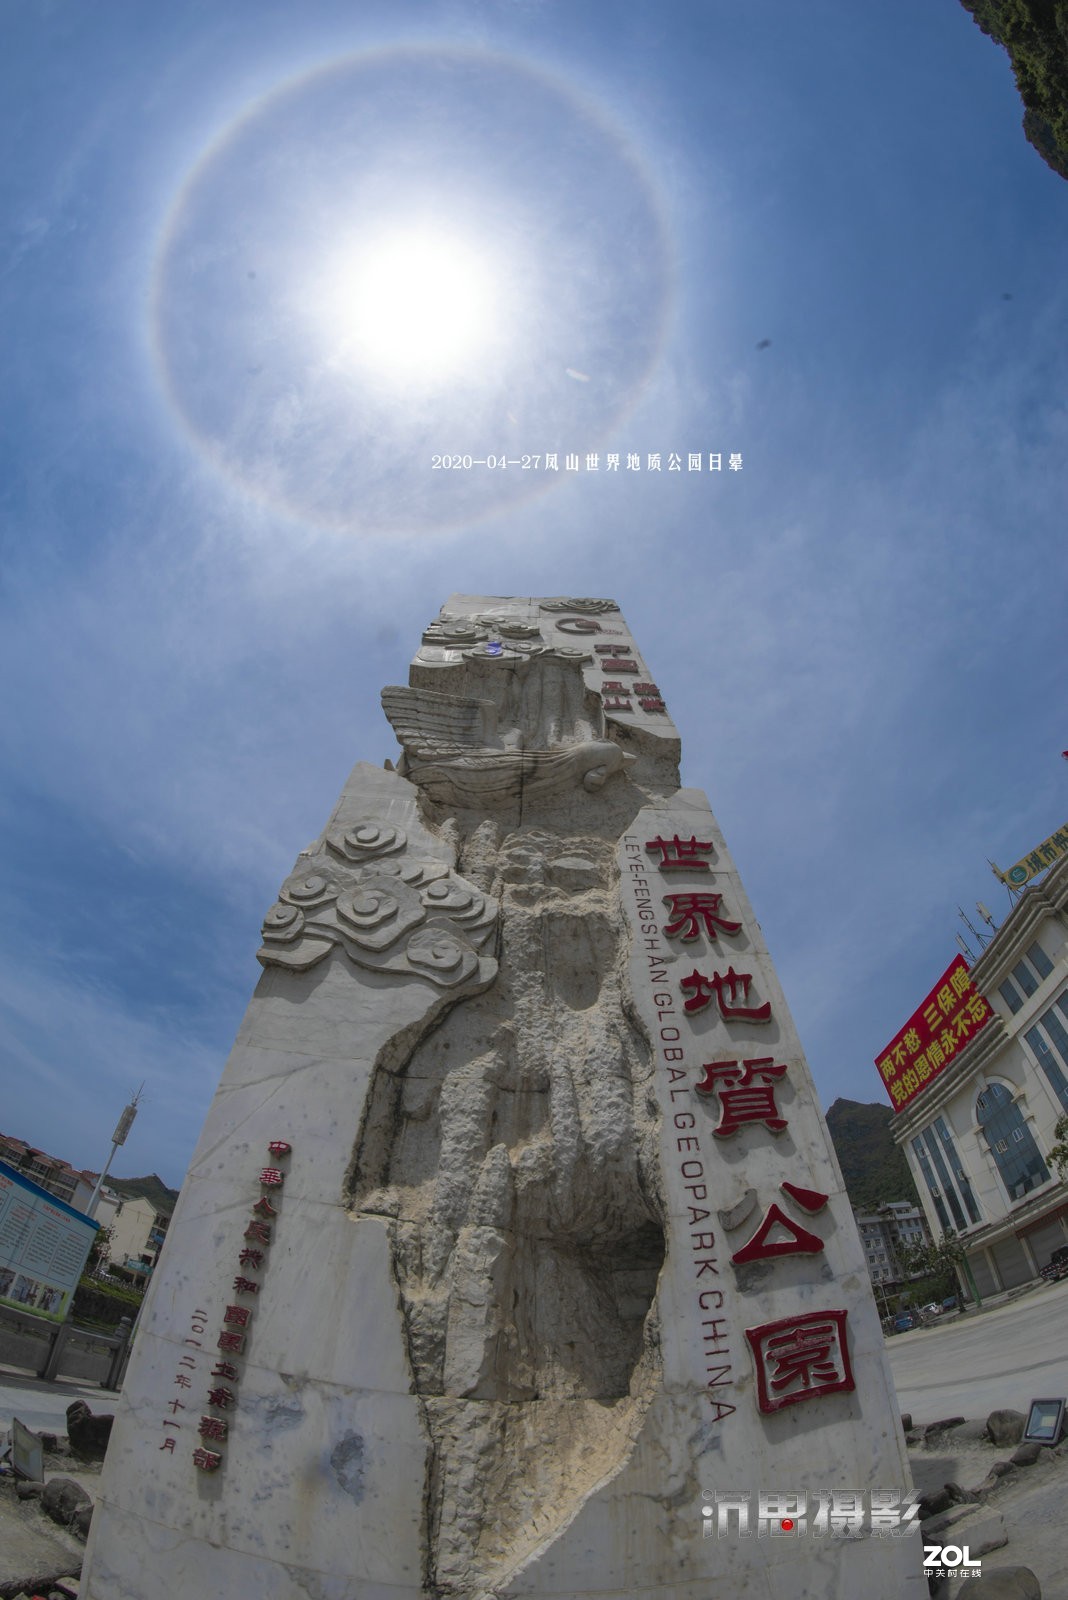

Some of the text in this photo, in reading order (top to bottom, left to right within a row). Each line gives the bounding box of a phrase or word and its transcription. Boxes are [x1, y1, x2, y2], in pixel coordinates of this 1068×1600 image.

[624, 834, 737, 1423] LEYE-FENGSHAN GLOBAL GEOPARK CHINA
[889, 992, 988, 1105] 党的恩情永不忘
